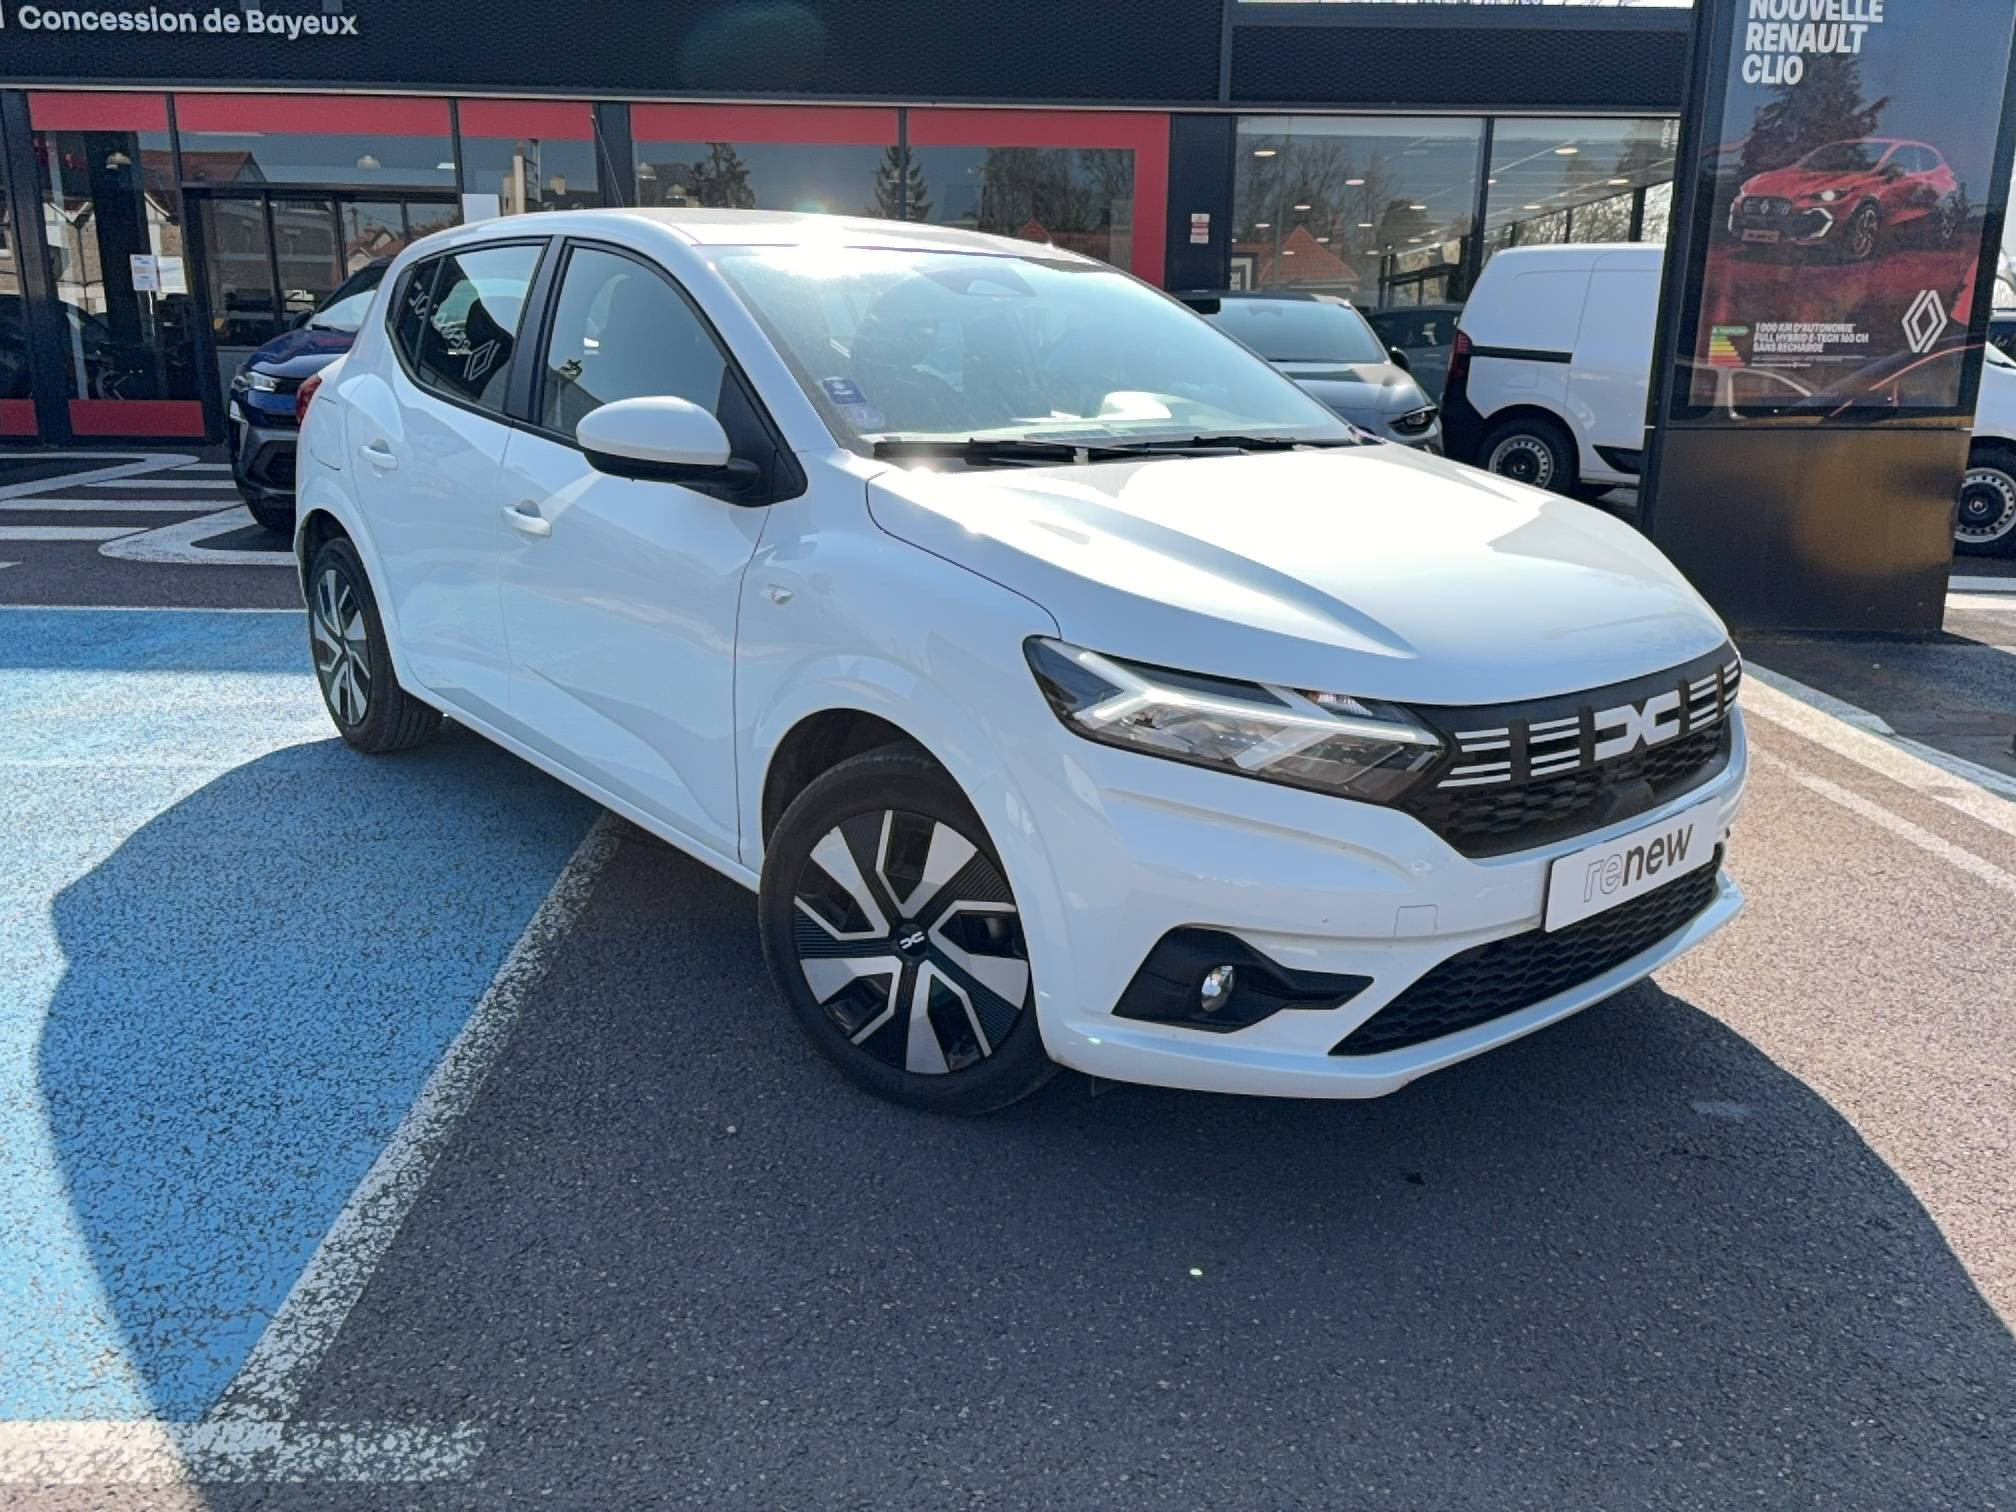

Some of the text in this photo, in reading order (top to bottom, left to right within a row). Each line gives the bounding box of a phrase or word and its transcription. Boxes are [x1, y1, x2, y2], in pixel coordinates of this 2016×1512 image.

[18, 6, 359, 40] Concession de Bayeux
[1748, 0, 1884, 22] NOUVELLE
[1745, 22, 1868, 54] RENAULT
[1741, 53, 1804, 85] CLIO
[1583, 823, 1694, 903] renew
